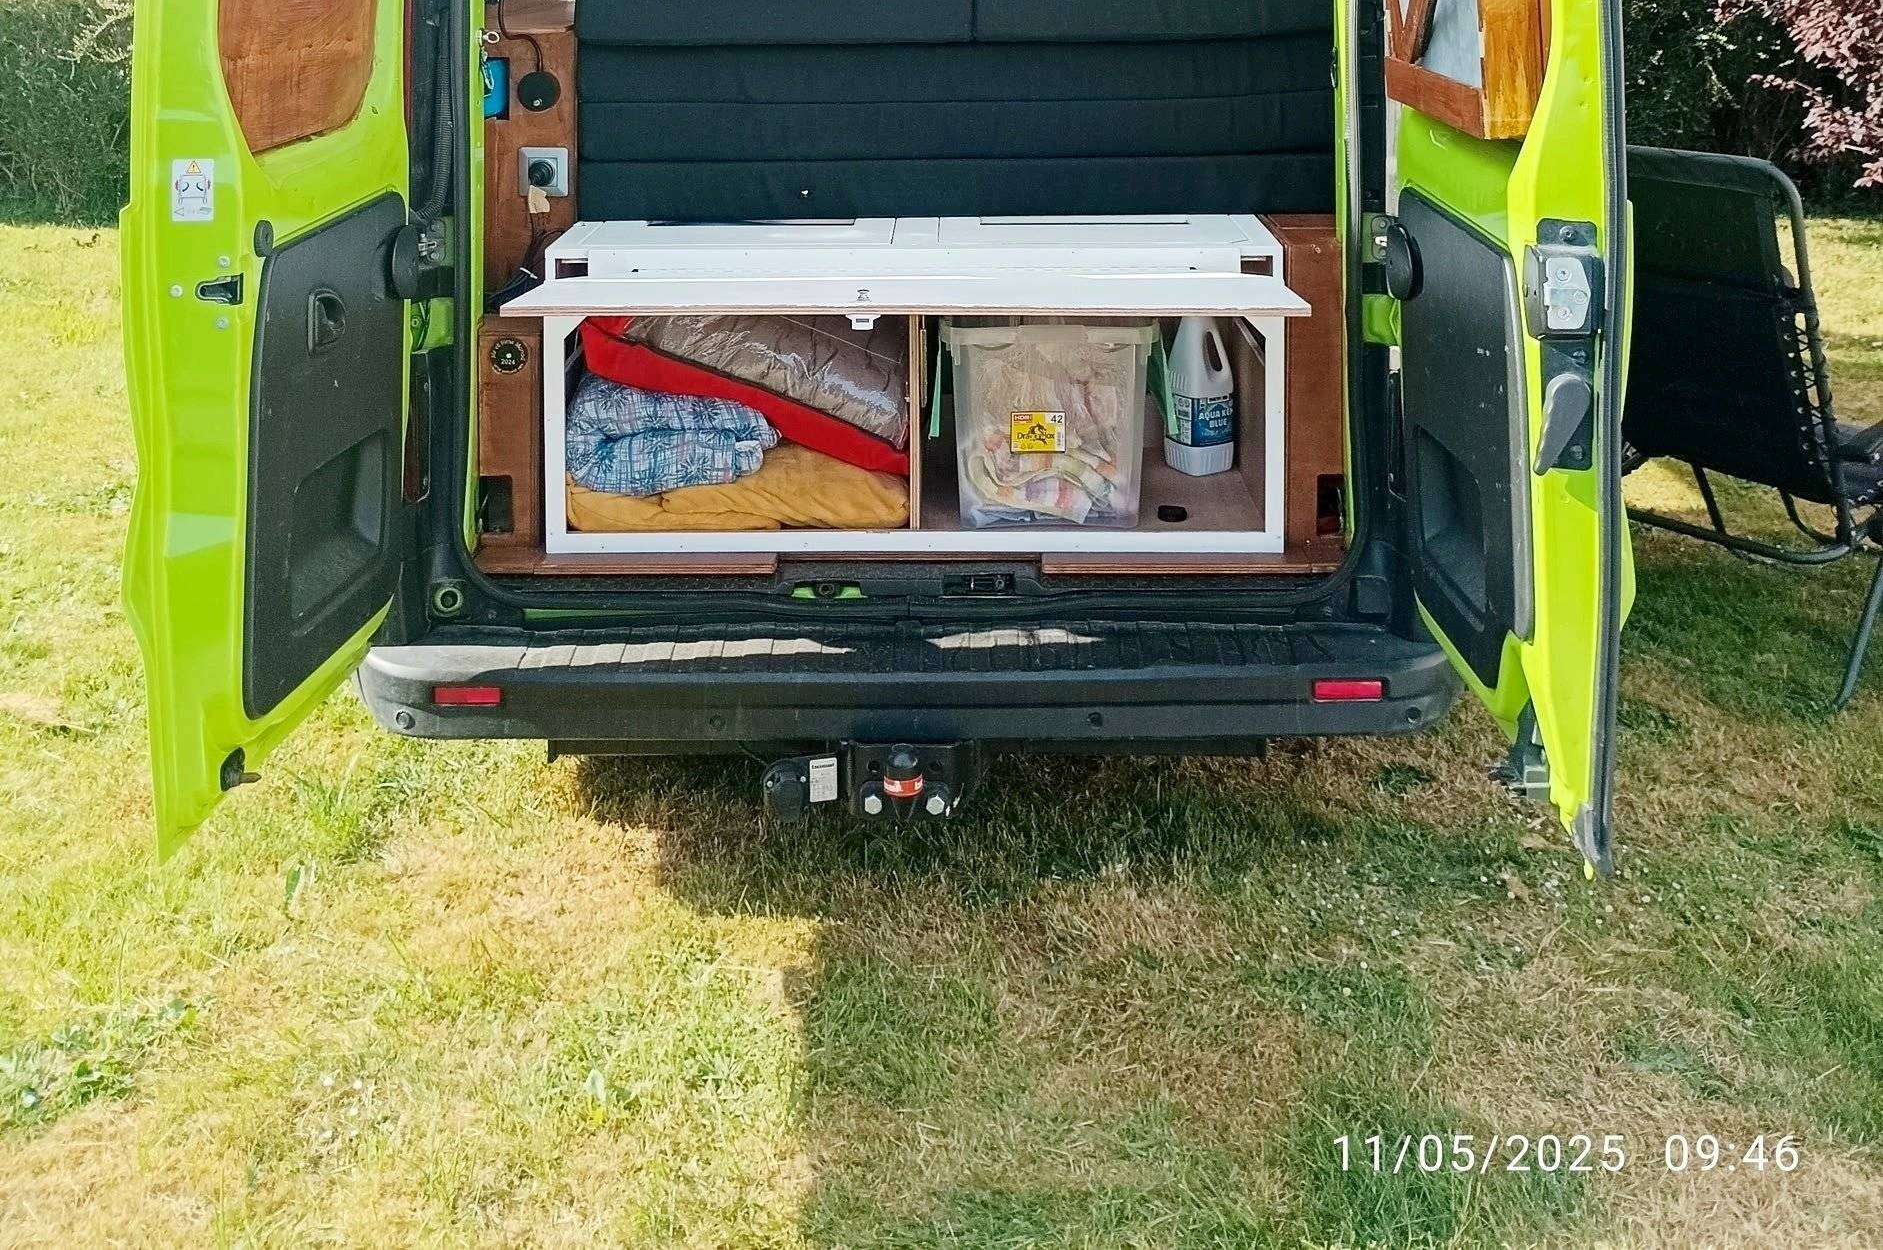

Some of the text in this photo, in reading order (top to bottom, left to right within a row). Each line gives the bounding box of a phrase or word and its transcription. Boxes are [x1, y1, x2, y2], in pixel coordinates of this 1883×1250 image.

[1050, 414, 1063, 424] 42
[1198, 410, 1221, 421] AQUA
[1209, 418, 1228, 428] BLUE
